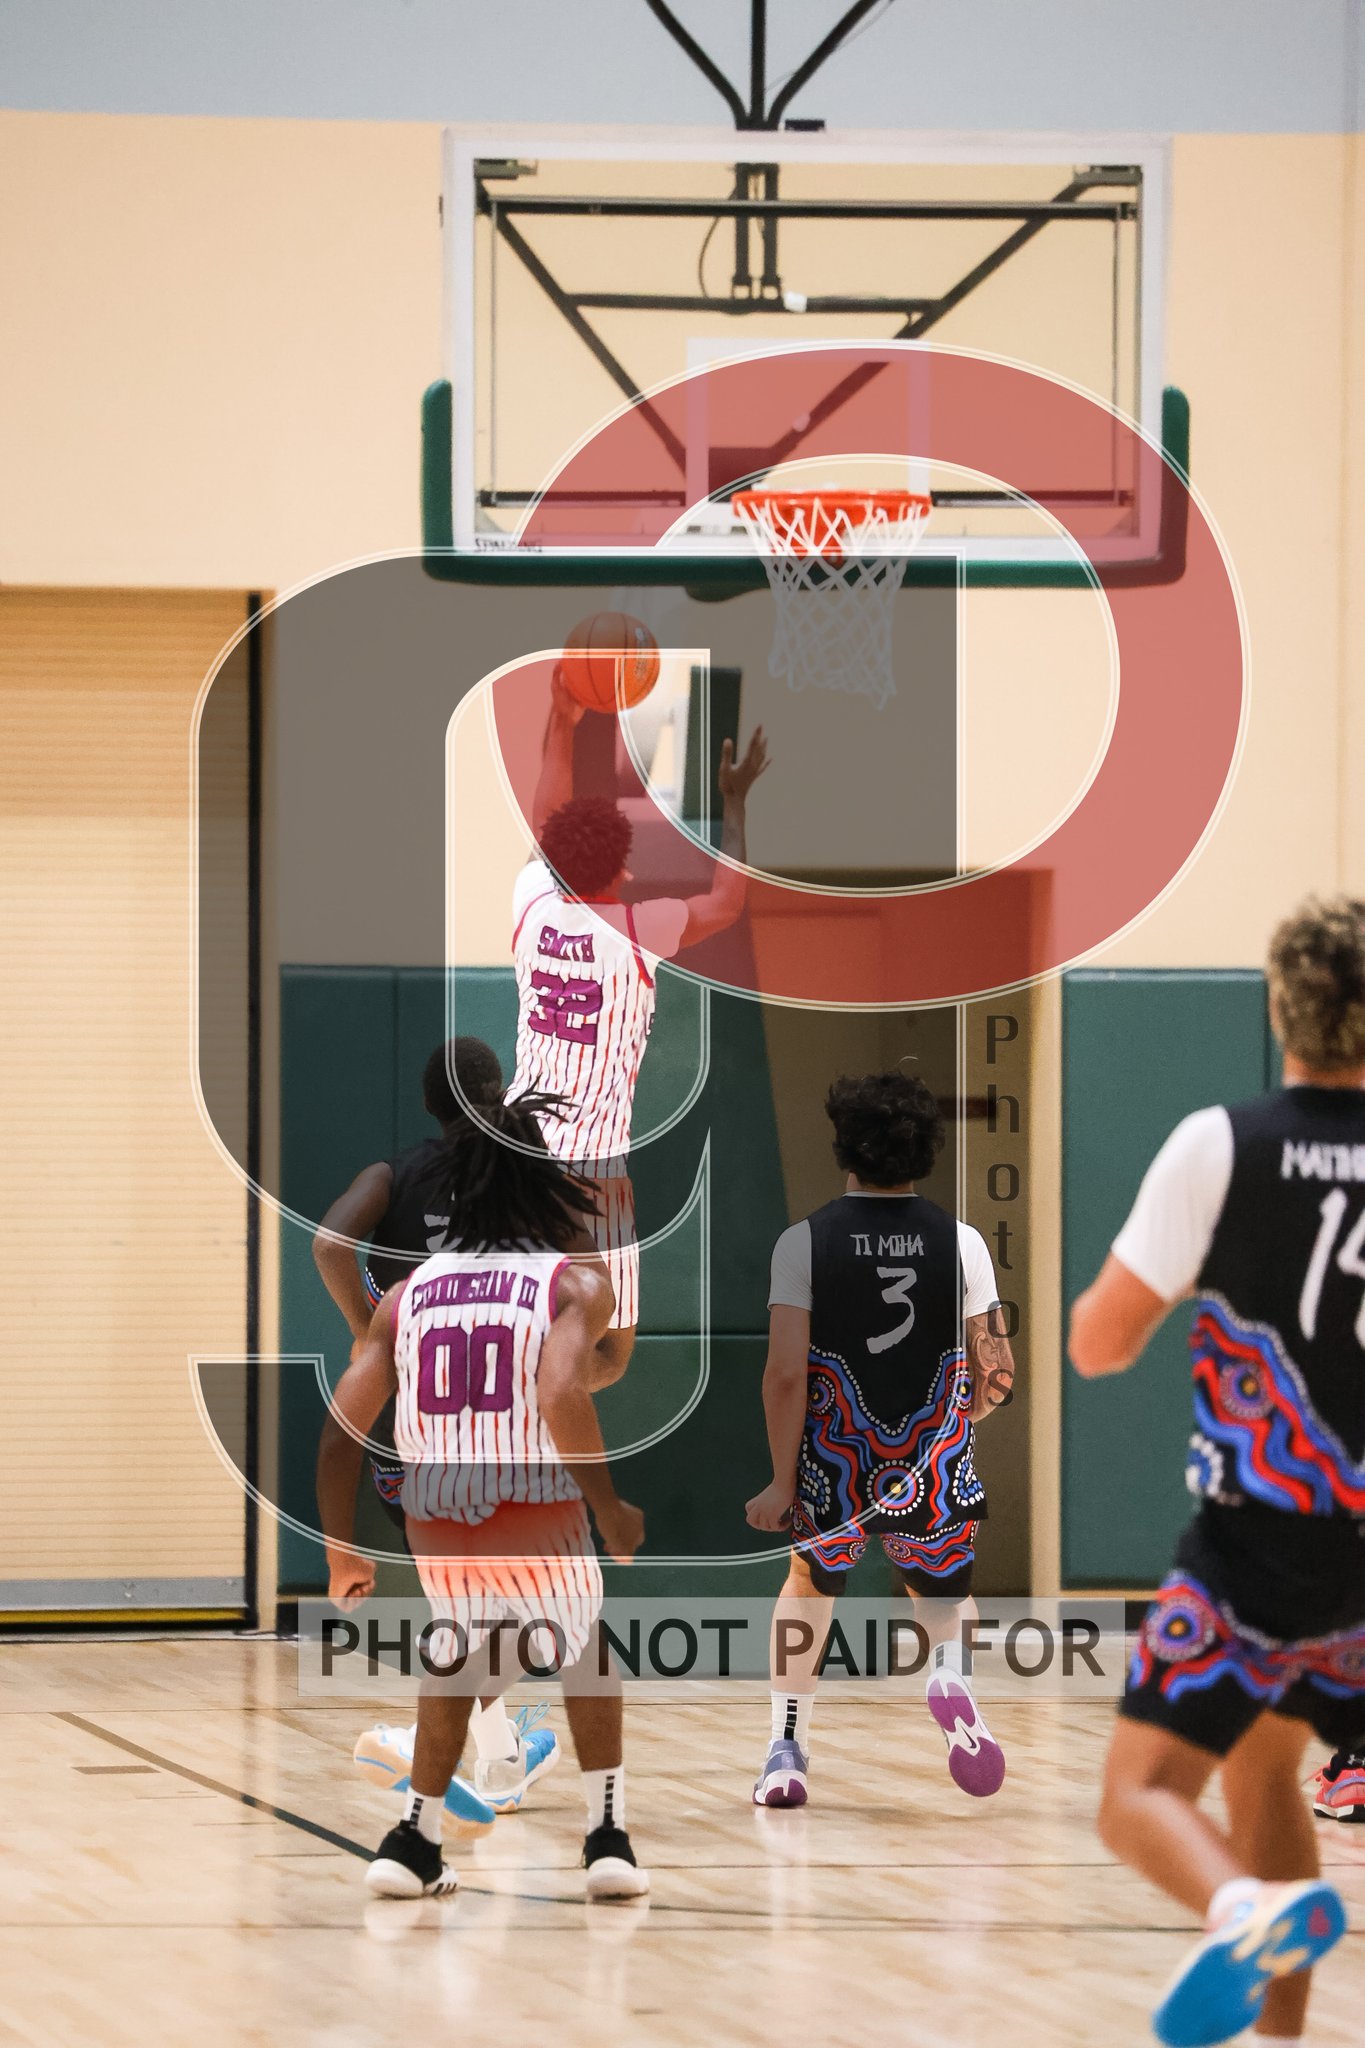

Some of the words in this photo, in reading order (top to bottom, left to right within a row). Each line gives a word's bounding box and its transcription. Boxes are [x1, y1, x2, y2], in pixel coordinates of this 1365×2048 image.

[537, 925, 595, 962] SMITH
[527, 969, 603, 1046] 32
[866, 1266, 918, 1354] 3
[418, 1325, 514, 1415] 00
